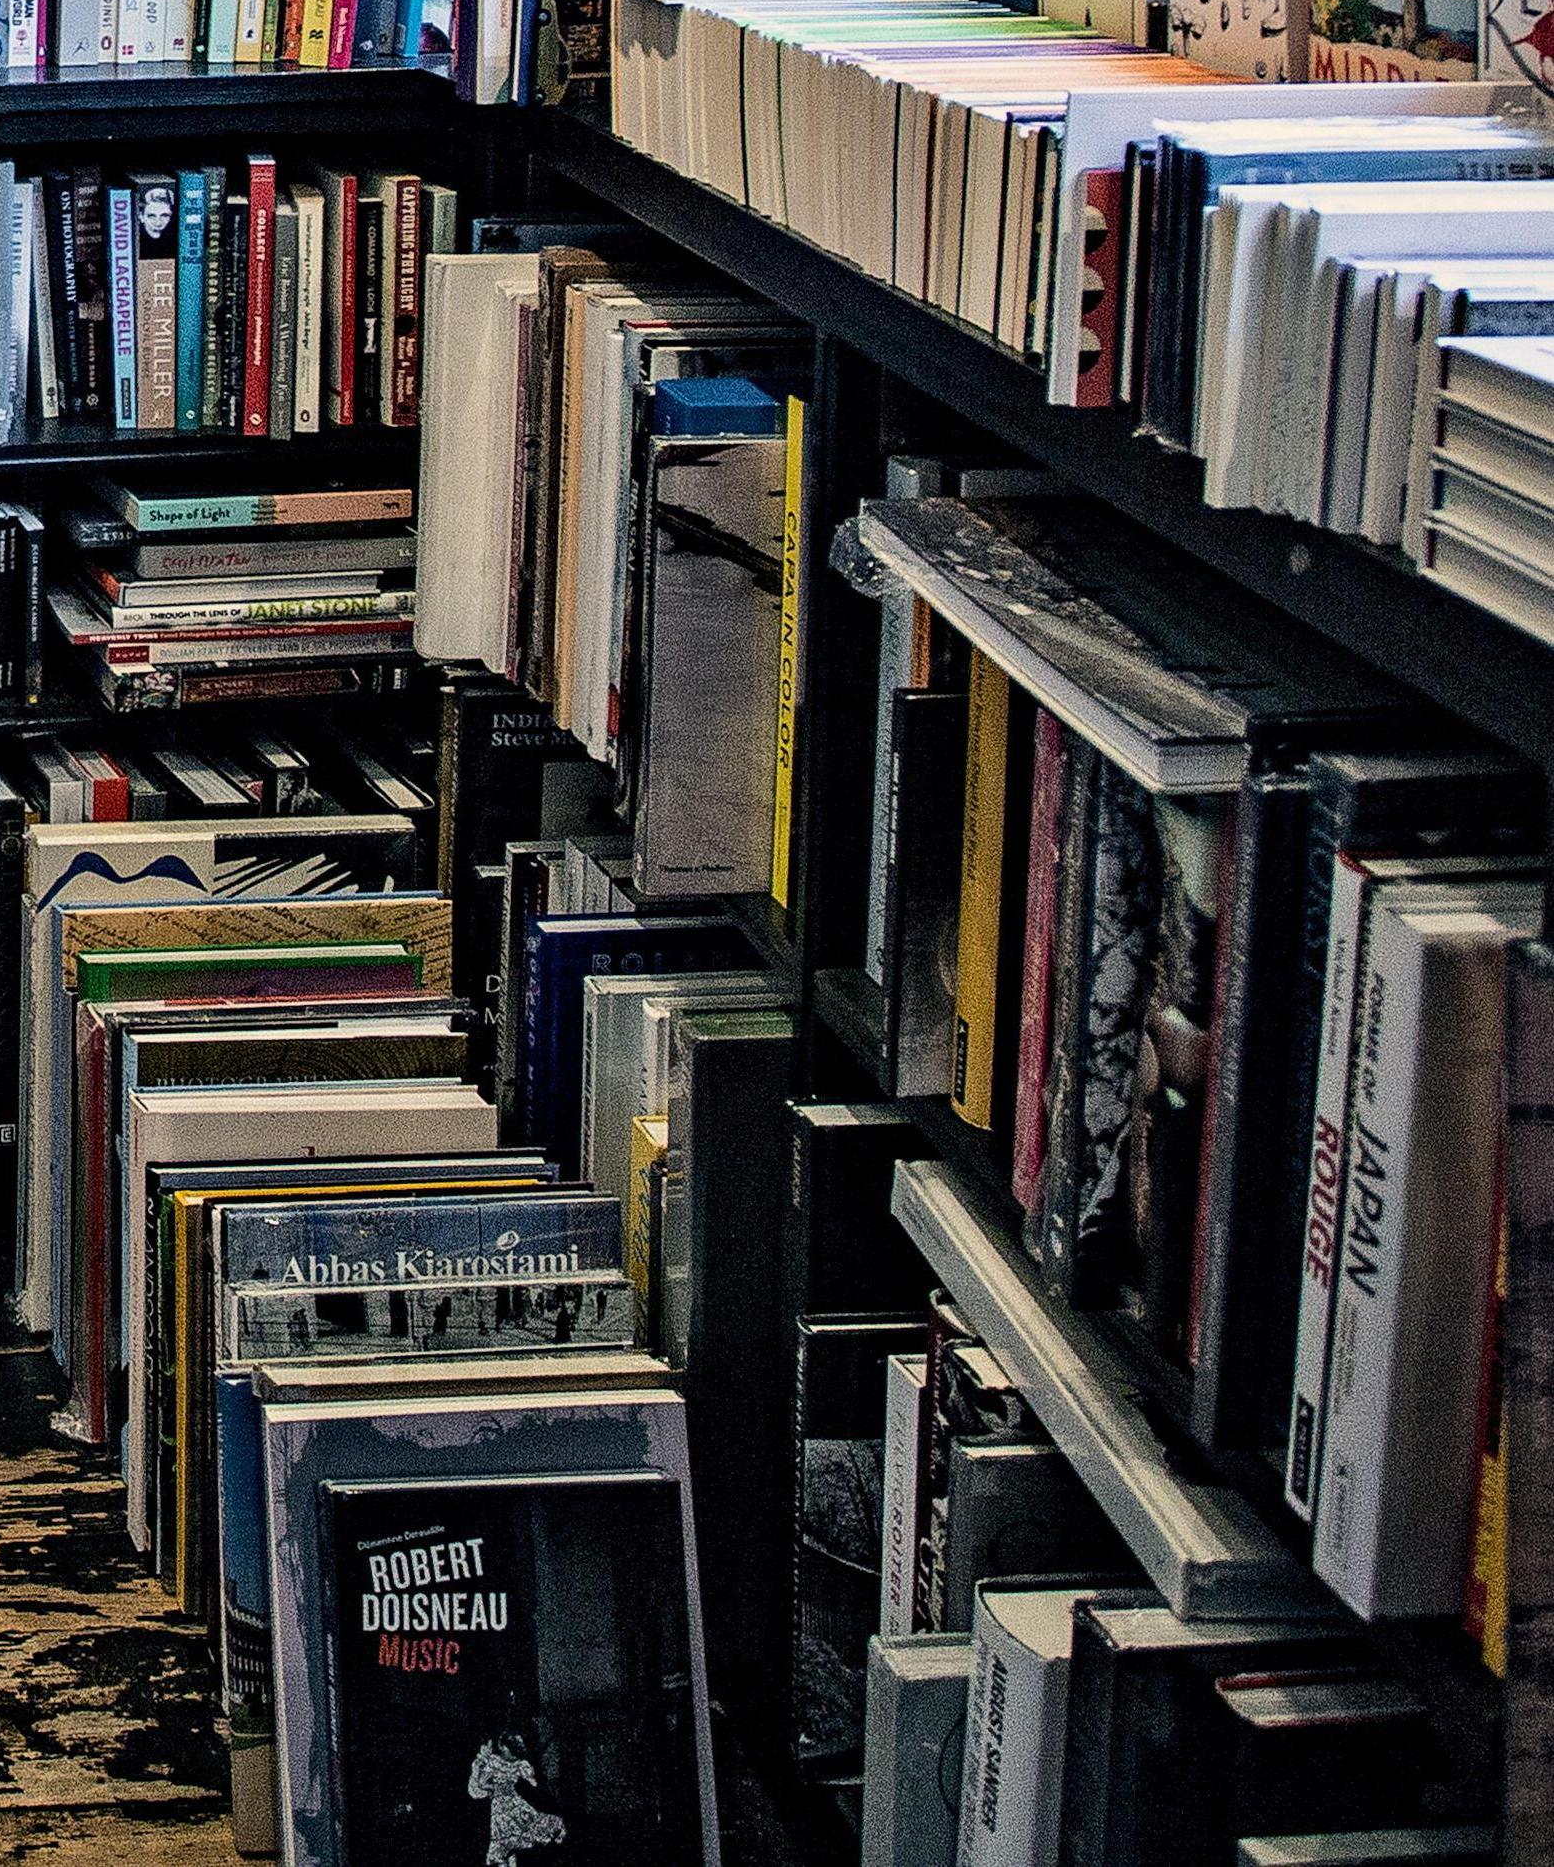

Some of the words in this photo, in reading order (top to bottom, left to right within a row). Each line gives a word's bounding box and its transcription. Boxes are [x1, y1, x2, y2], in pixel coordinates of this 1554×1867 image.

[115, 200, 131, 250] DAVID
[117, 255, 133, 357] LACHAPELLE
[154, 268, 172, 308] LEE
[154, 318, 171, 399] MILLER
[148, 509, 180, 524] Shape
[186, 509, 199, 522] of
[201, 507, 232, 523] Light
[784, 510, 797, 597] CAPA
[244, 600, 310, 620] JANET
[311, 597, 379, 617] STONE
[783, 613, 795, 646] IN
[779, 658, 794, 769] COLOR
[1307, 1117, 1339, 1291] ROUGE
[1347, 1113, 1389, 1295] JAPAN
[280, 1255, 388, 1286] Abbas
[397, 1244, 580, 1279] Kiarostami
[369, 1538, 487, 1593] ROBERT
[362, 1593, 508, 1632] DOISNEAU
[377, 1635, 461, 1673] MUSIC
